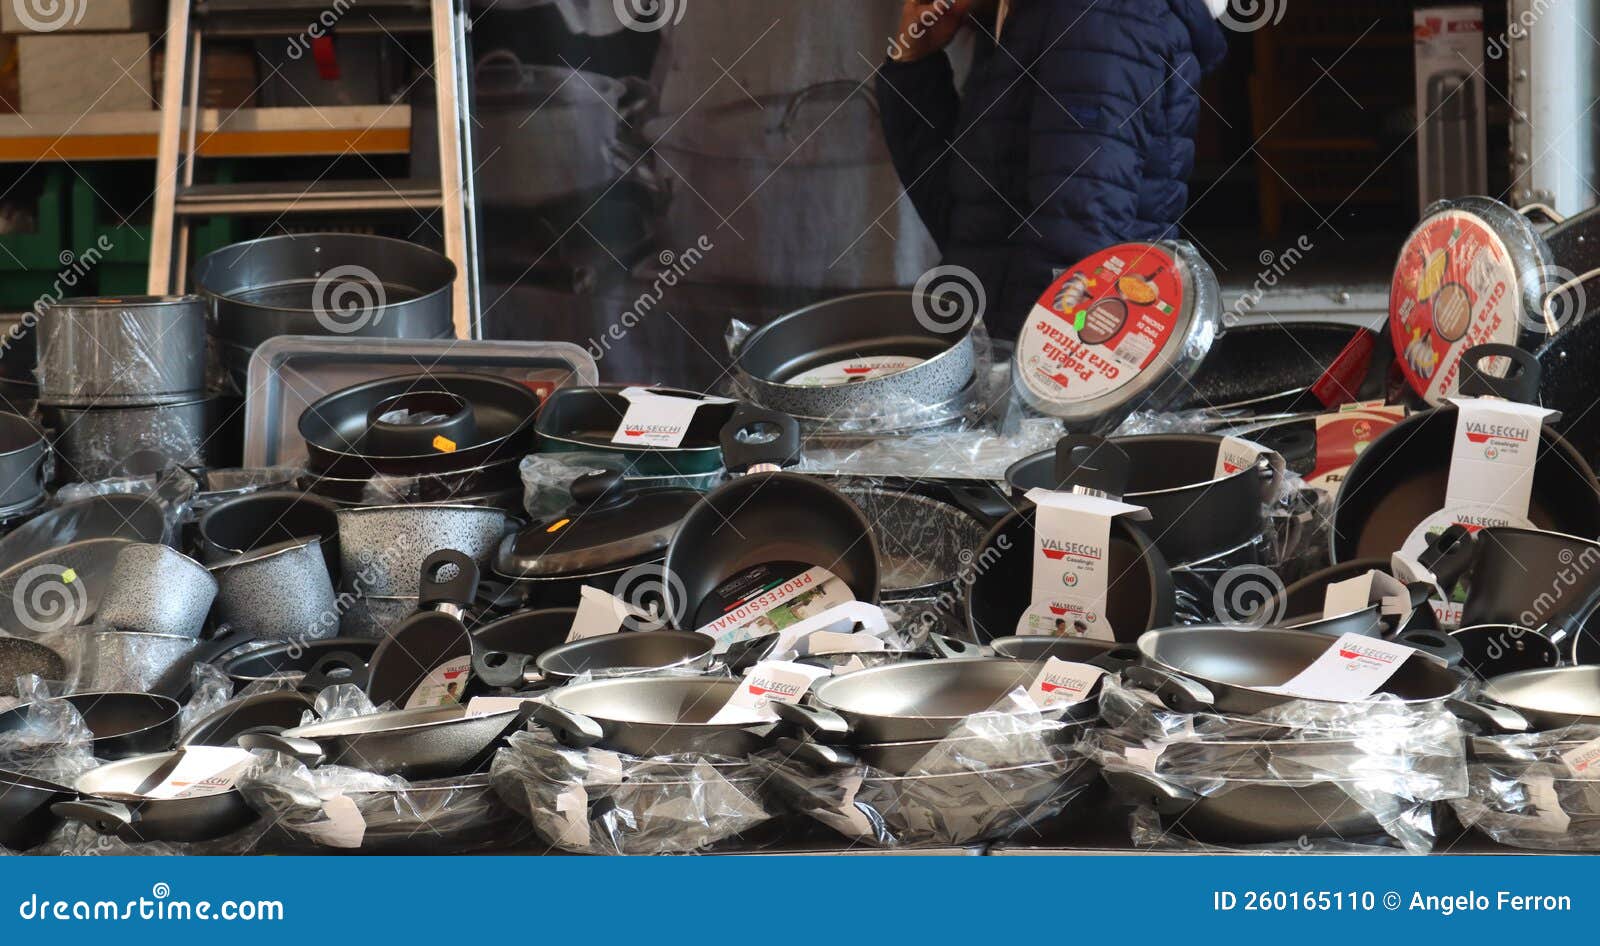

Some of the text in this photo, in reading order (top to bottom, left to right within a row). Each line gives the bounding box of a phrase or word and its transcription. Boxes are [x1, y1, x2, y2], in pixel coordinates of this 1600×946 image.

[1478, 281, 1506, 321] Gira
[1036, 321, 1087, 360] Frittate
[1042, 342, 1095, 382] Padella
[1087, 349, 1120, 380] Gira
[625, 424, 682, 433] VALSECCHI
[1465, 422, 1529, 440] VALSECCHI
[1457, 513, 1509, 528] VALSECCHI
[1041, 538, 1102, 560] VALSECCHI
[708, 573, 813, 632] PROFESSIONAL
[1343, 642, 1398, 661] VALSECCHI
[751, 676, 800, 694] VALSECCHI
